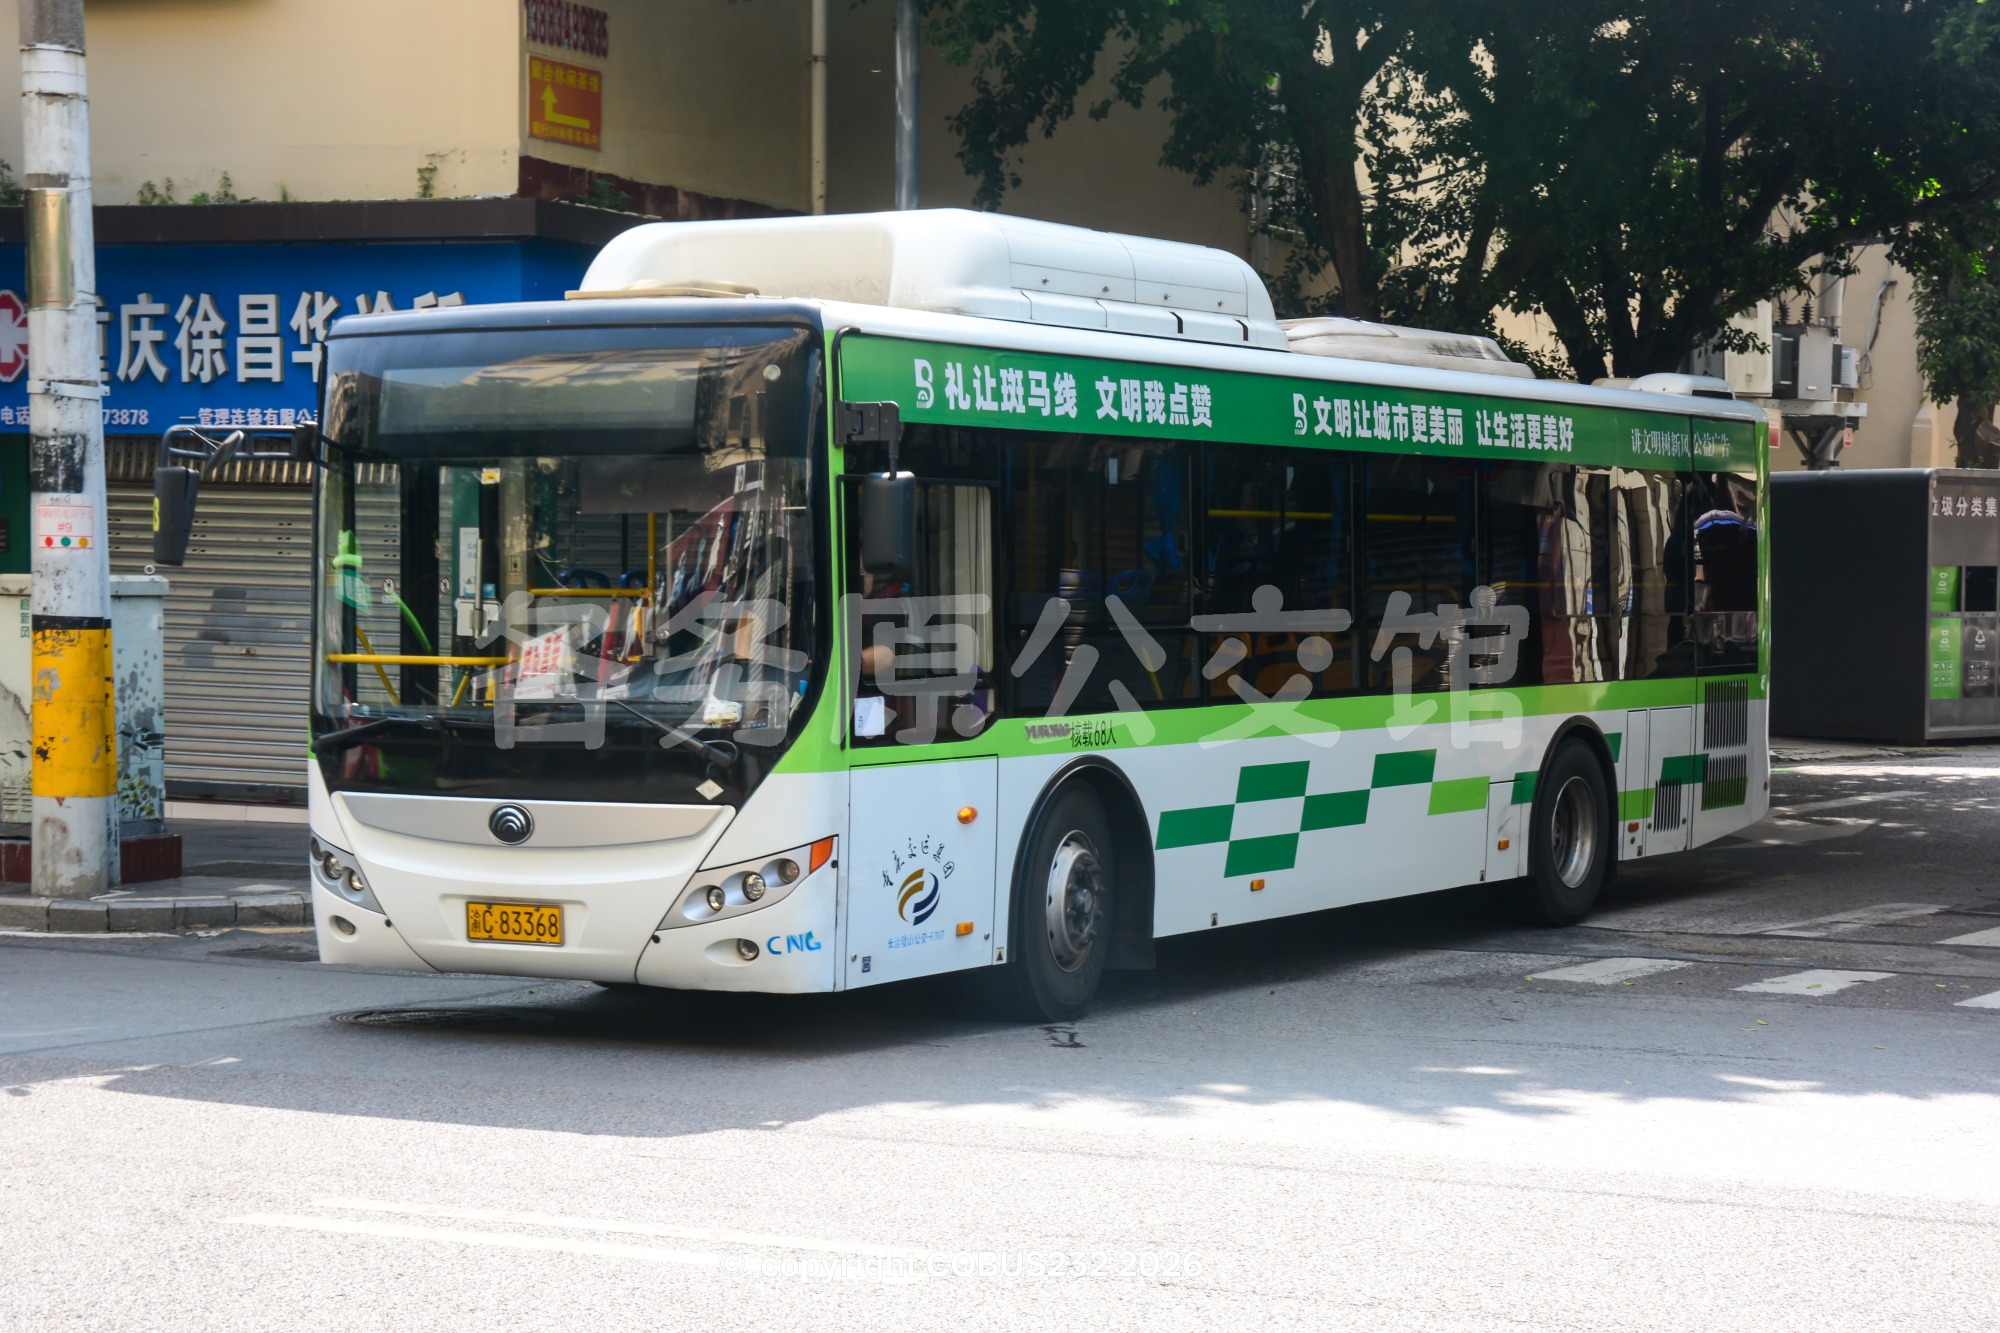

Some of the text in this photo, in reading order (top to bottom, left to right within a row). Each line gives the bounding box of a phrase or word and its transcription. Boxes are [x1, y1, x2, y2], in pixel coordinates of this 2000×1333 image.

[97, 291, 467, 383] 庆徐昌华
[944, 362, 1213, 428] 礼让斑马线 文明我点赞
[1313, 395, 1574, 452] 文明让城市更美丽 让生活更美好
[1631, 428, 1730, 458] 讲文明树新风 公益广告
[767, 931, 821, 955] CNG
